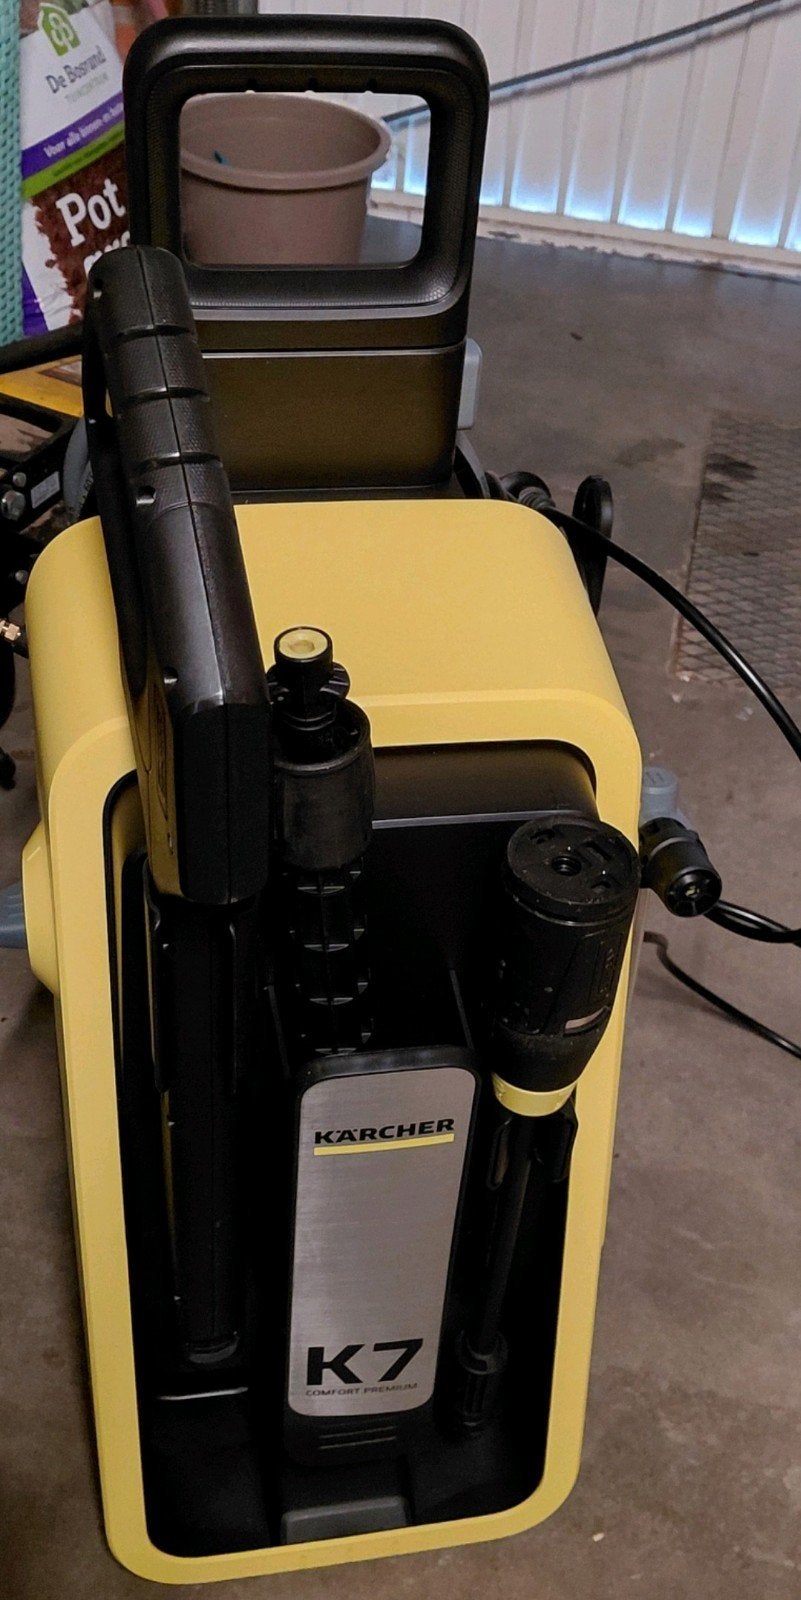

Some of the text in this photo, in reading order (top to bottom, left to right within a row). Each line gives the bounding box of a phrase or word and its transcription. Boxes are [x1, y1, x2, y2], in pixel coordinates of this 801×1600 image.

[46, 74, 68, 93] De
[56, 178, 126, 248] Pot
[314, 1118, 455, 1145] KÄRCHER
[306, 1338, 424, 1386] K7
[305, 1382, 418, 1397] COMFORT PREMIUM
